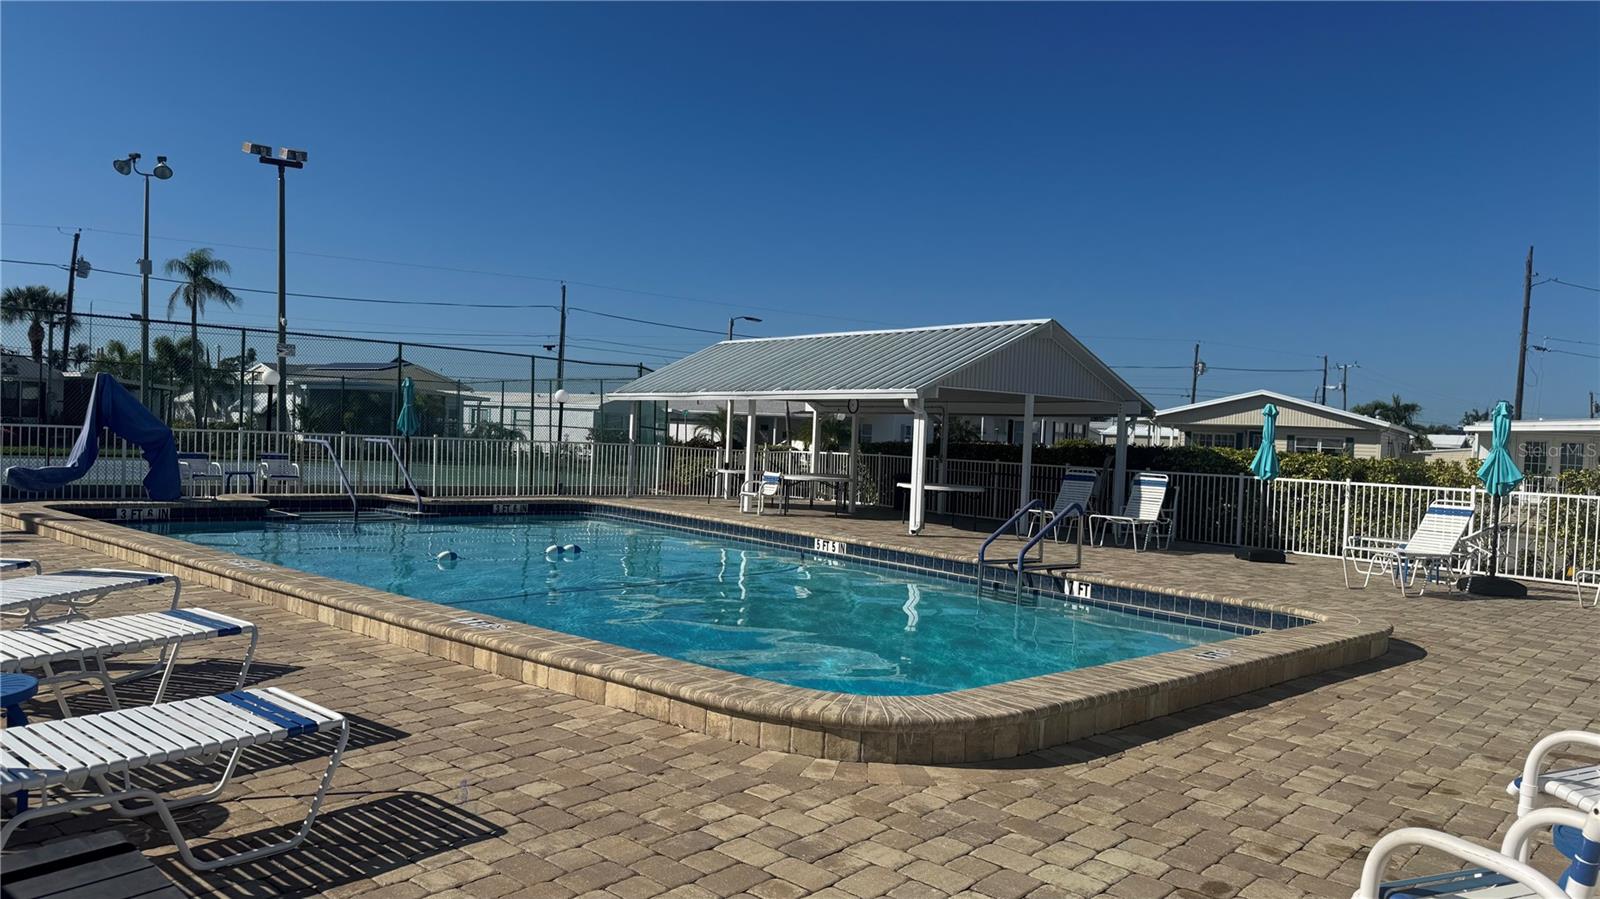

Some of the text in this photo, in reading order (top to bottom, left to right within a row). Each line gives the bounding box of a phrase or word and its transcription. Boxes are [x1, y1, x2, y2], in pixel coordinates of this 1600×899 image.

[120, 509, 127, 519] 3
[131, 509, 143, 520] FT
[158, 509, 169, 520] IN
[822, 540, 830, 552] FT
[1078, 582, 1090, 598] FT
